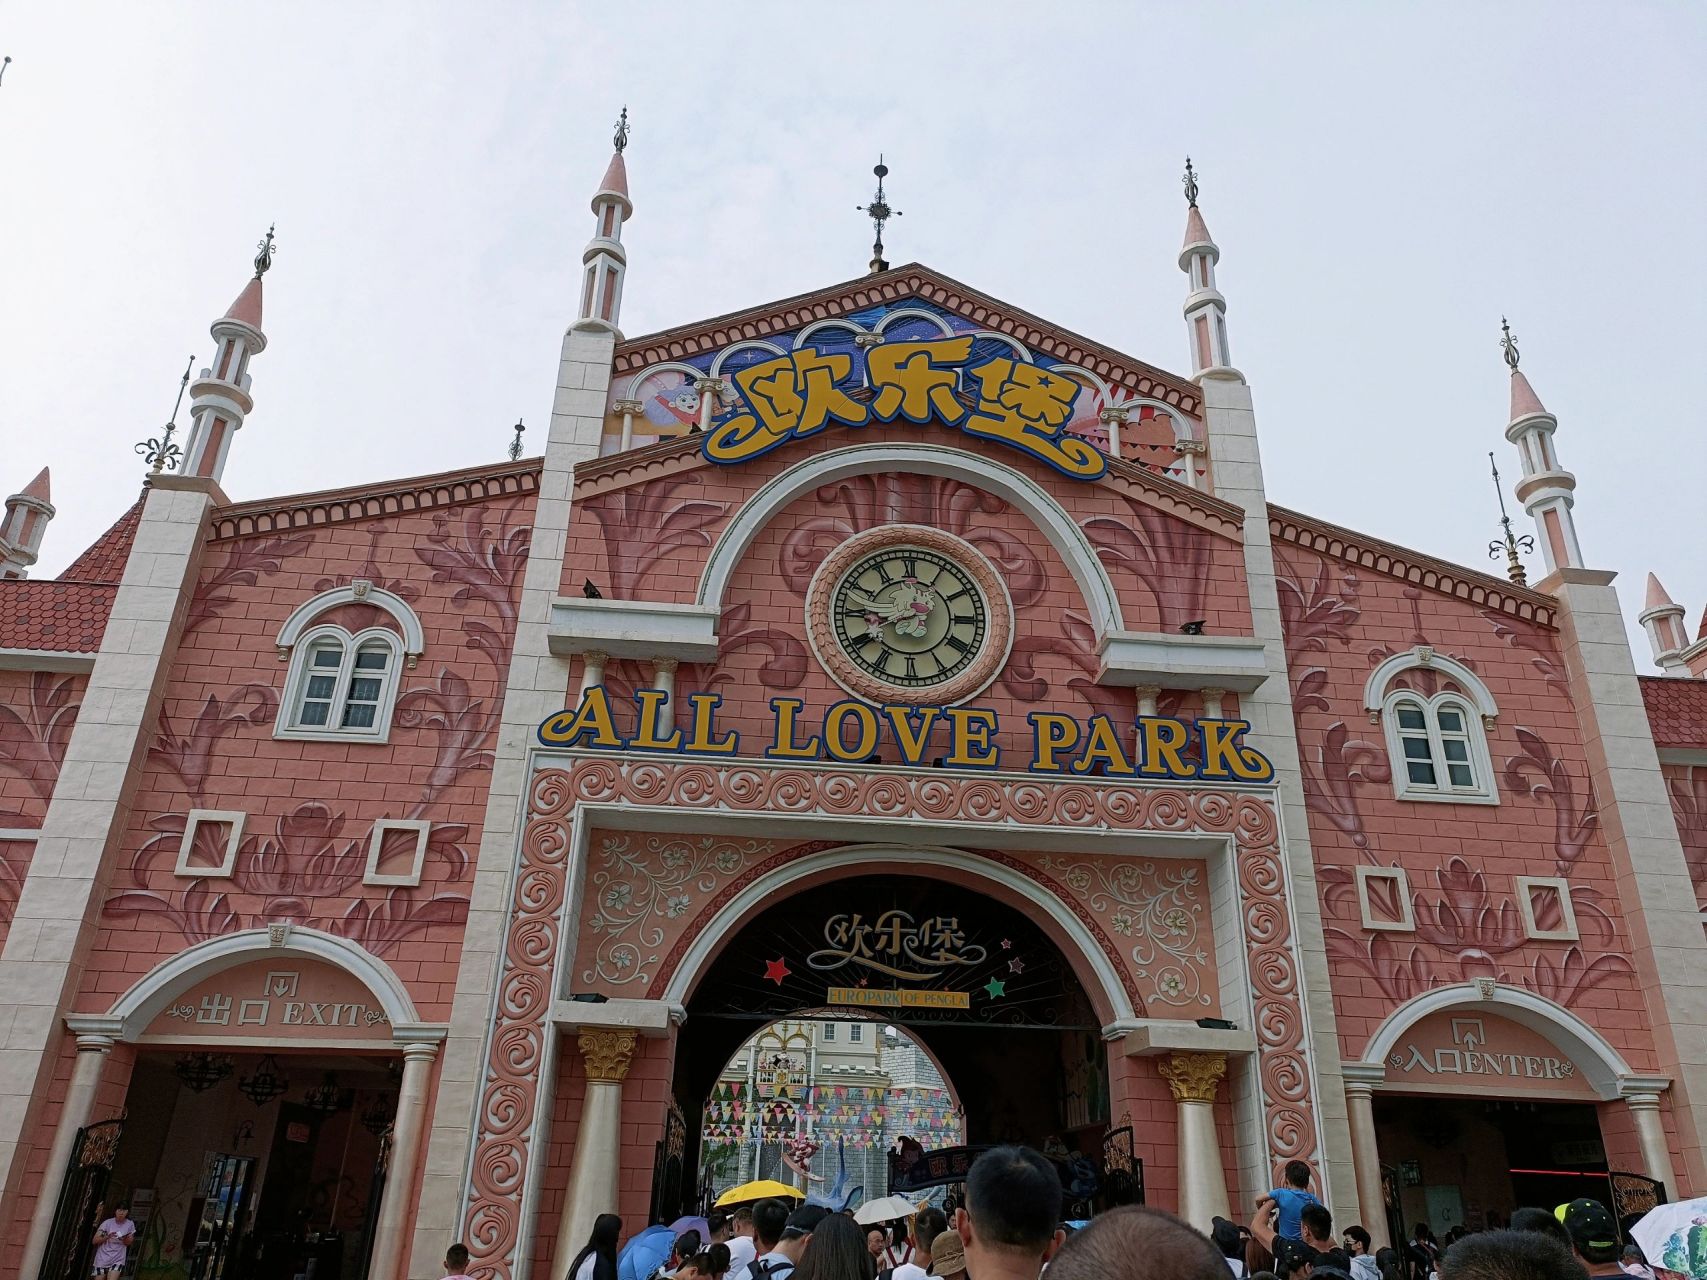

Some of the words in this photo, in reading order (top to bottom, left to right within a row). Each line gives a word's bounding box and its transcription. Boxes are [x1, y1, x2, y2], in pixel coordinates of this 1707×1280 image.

[702, 335, 1108, 480] 欧乐堡
[872, 564, 893, 584] XI
[901, 560, 917, 578] XII
[851, 581, 875, 597] X
[946, 588, 967, 602] II
[954, 614, 975, 625] III
[904, 657, 918, 678] VI
[931, 650, 947, 672] V
[537, 685, 740, 757] ALL
[766, 697, 1000, 770] LOVE
[1028, 711, 1275, 783] PARK
[806, 910, 987, 981] 欧乐堡
[829, 988, 900, 1005] EUROPARK
[904, 992, 921, 1004] OF
[196, 993, 271, 1027] 出口
[280, 1002, 367, 1028] EXIT
[1404, 1044, 1462, 1075] 入口
[1464, 1051, 1565, 1080] ENTER
